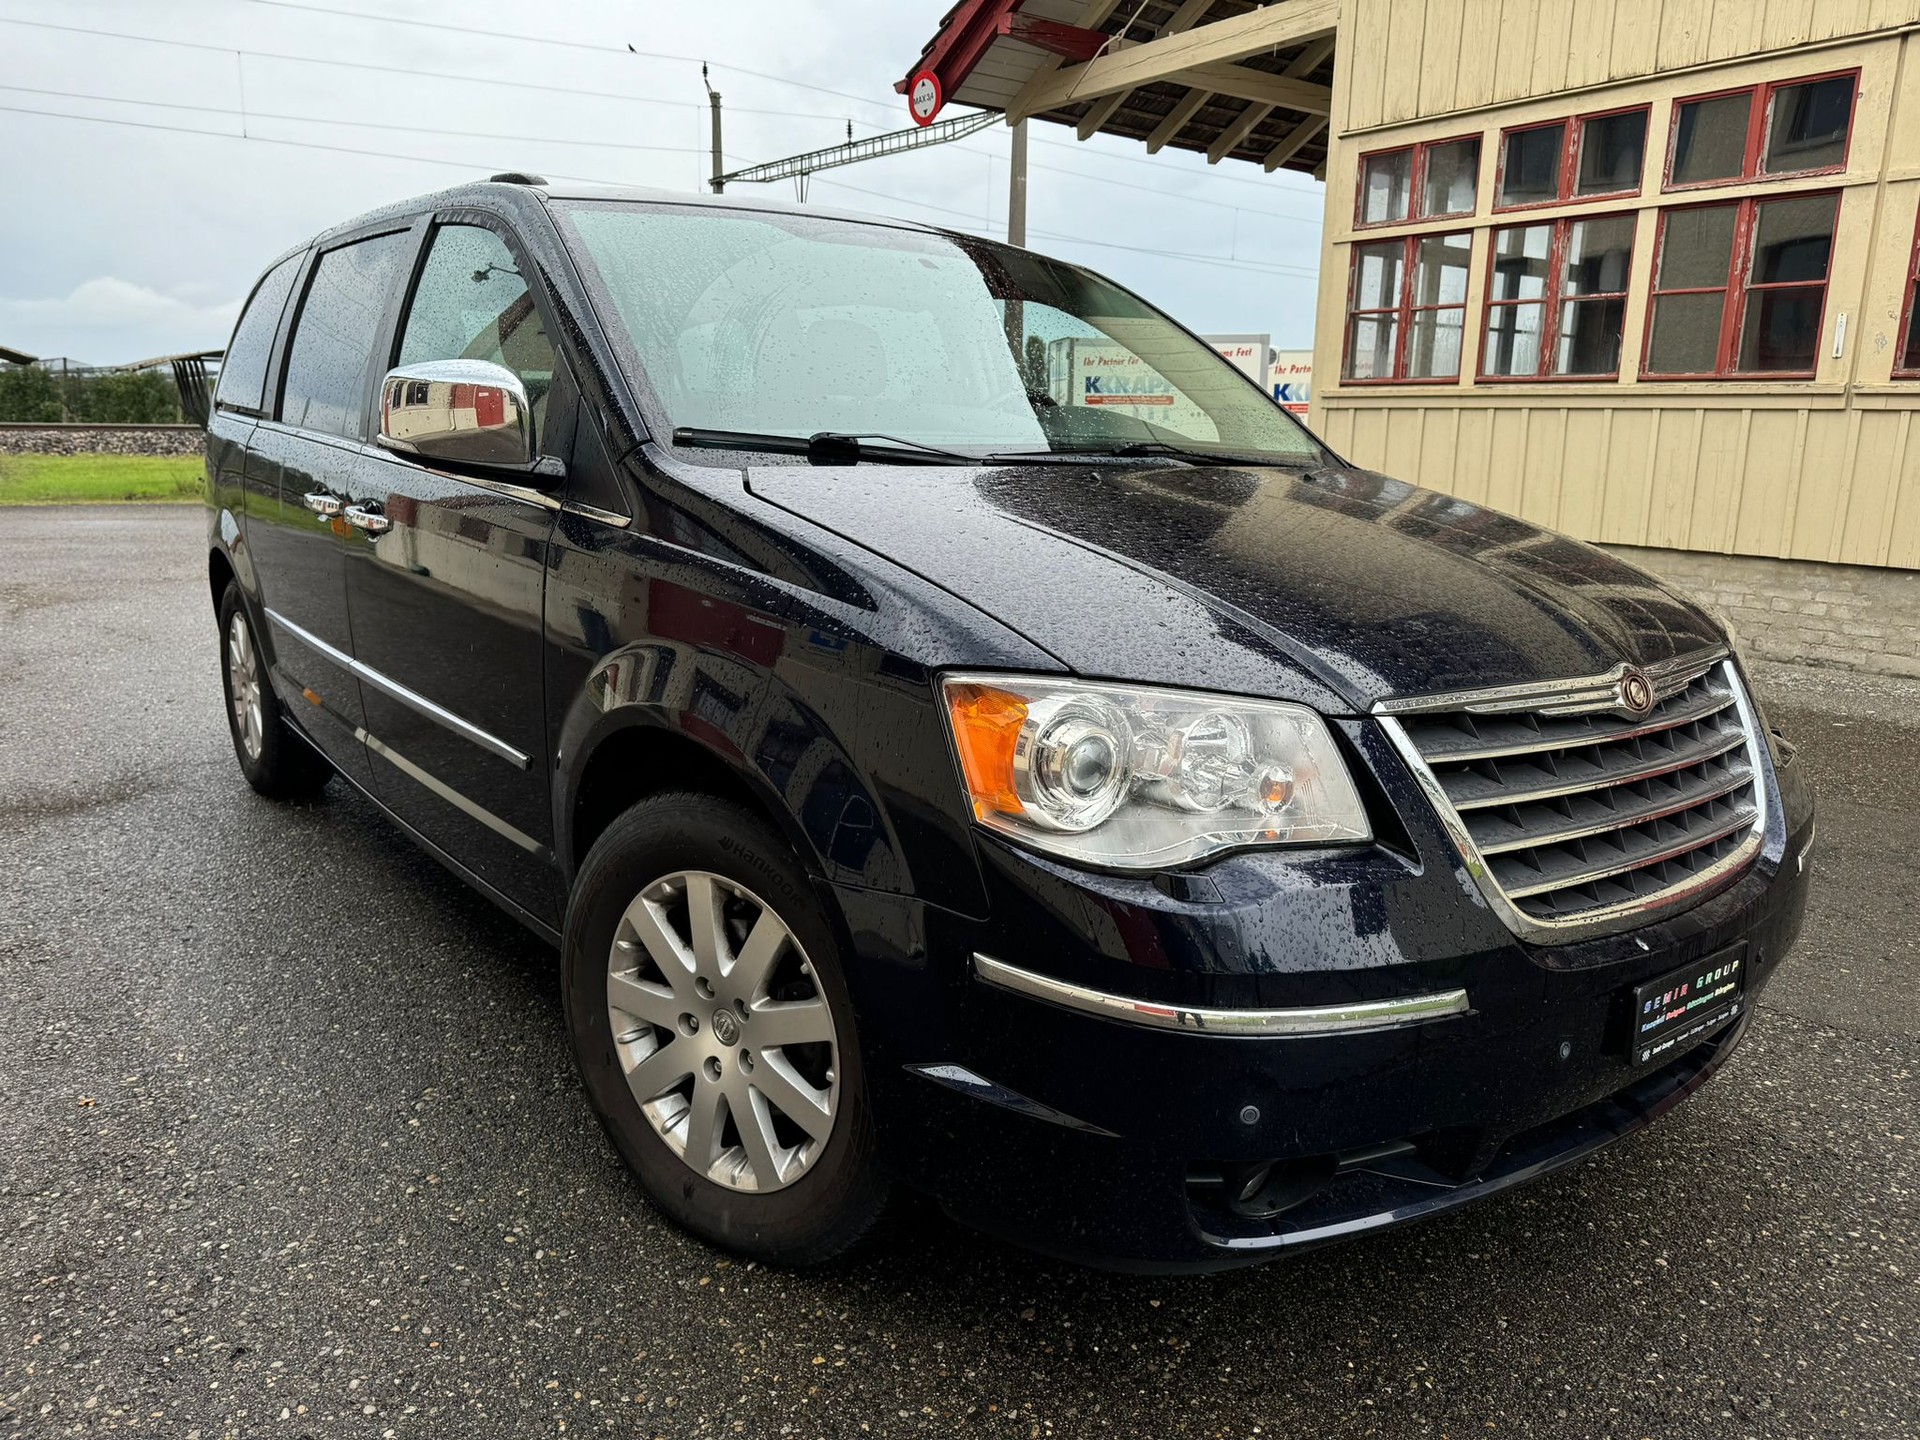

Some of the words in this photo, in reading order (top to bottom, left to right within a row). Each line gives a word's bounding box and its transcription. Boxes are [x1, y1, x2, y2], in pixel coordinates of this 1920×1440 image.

[914, 94, 926, 104] MAX
[1083, 357, 1094, 366] Ihr
[1098, 357, 1125, 366] Partner
[1236, 347, 1253, 357] Fest
[1274, 366, 1287, 375] Ihr
[1643, 983, 1689, 1014] SEMIR
[1696, 960, 1739, 989] GROUP
